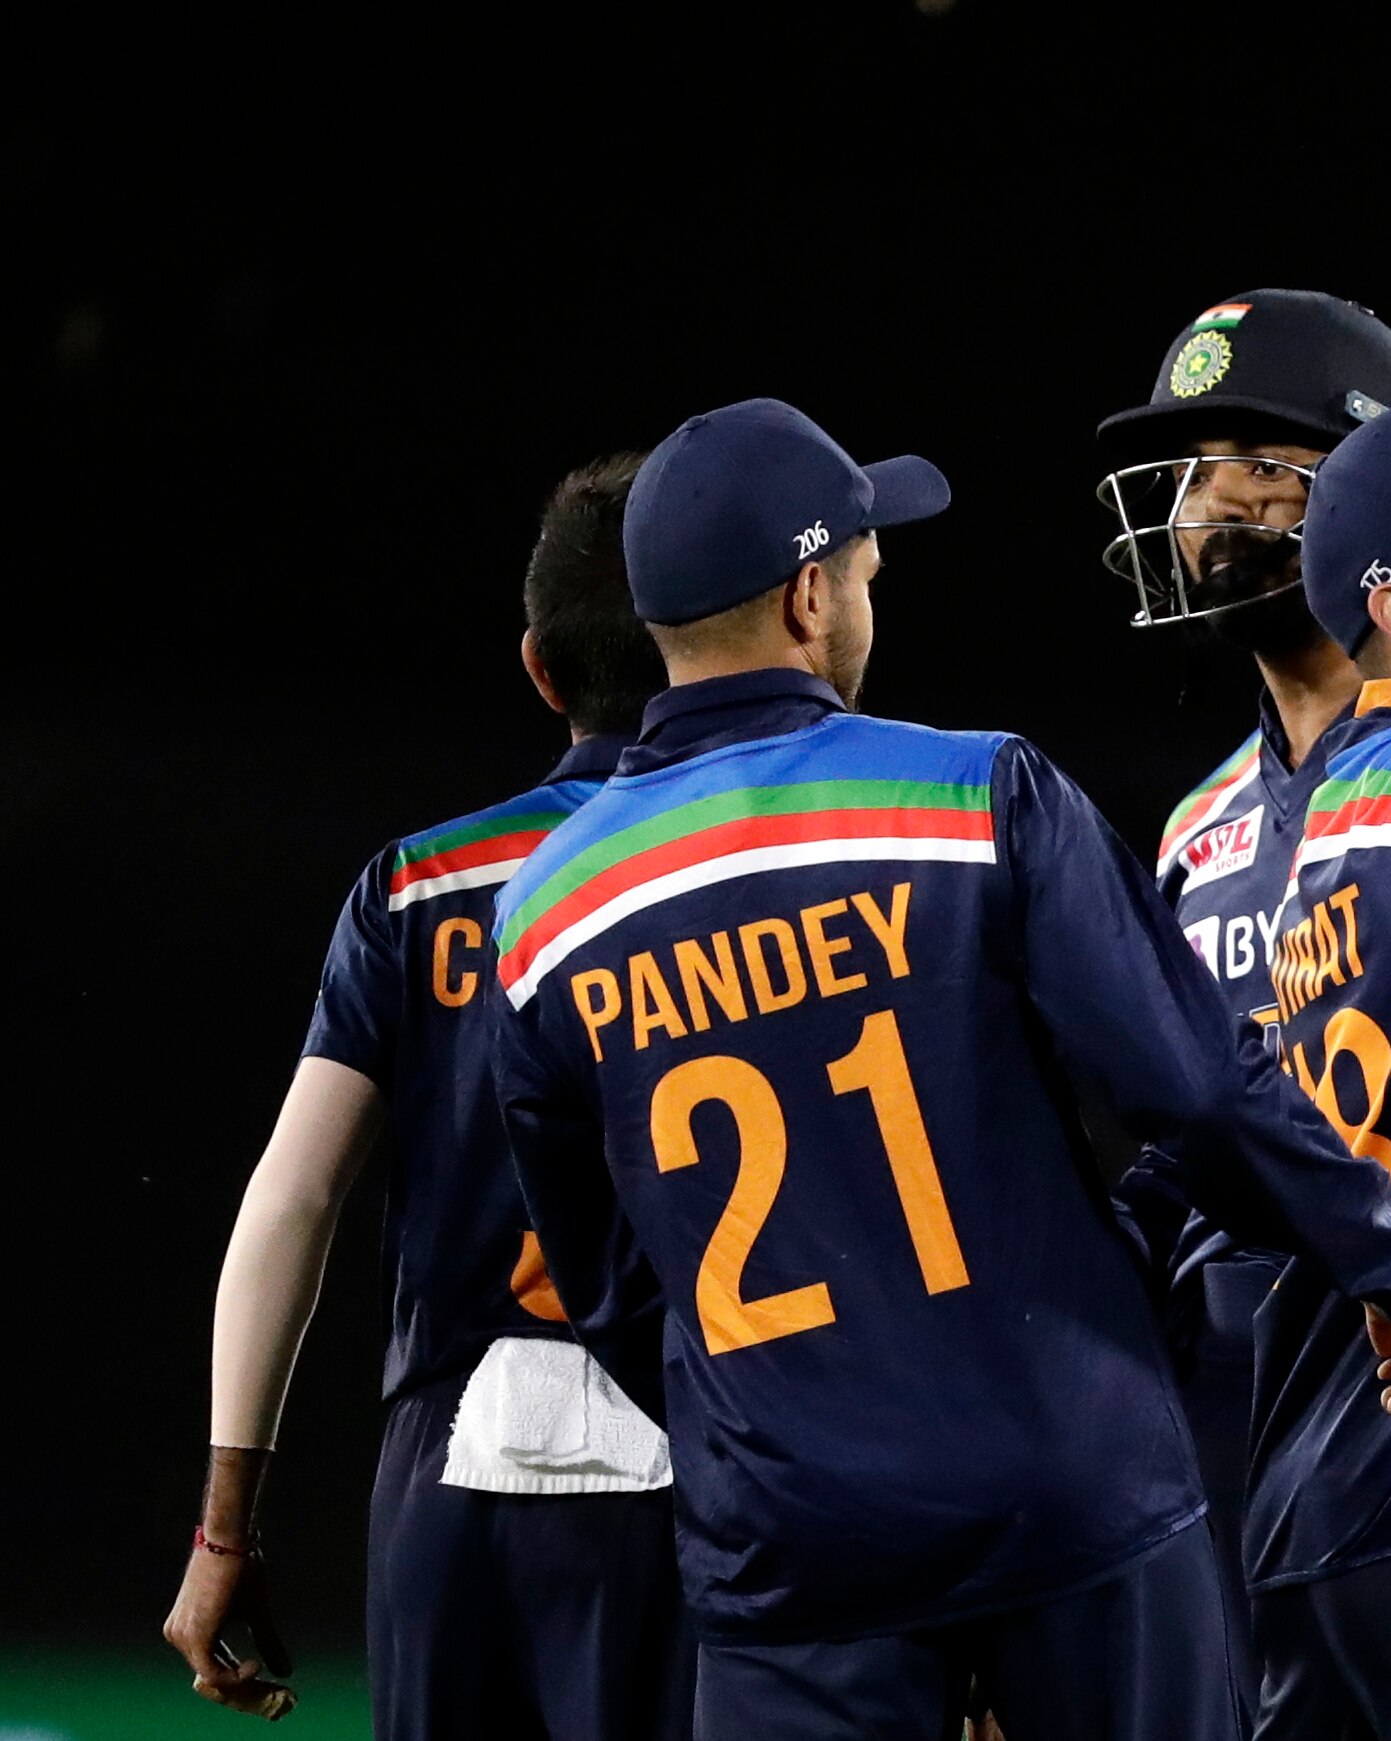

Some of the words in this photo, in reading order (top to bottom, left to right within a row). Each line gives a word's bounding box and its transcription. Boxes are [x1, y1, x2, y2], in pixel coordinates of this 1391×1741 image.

[792, 520, 829, 559] 206
[570, 882, 911, 1063] PANDEY
[650, 1009, 970, 1356] 21
